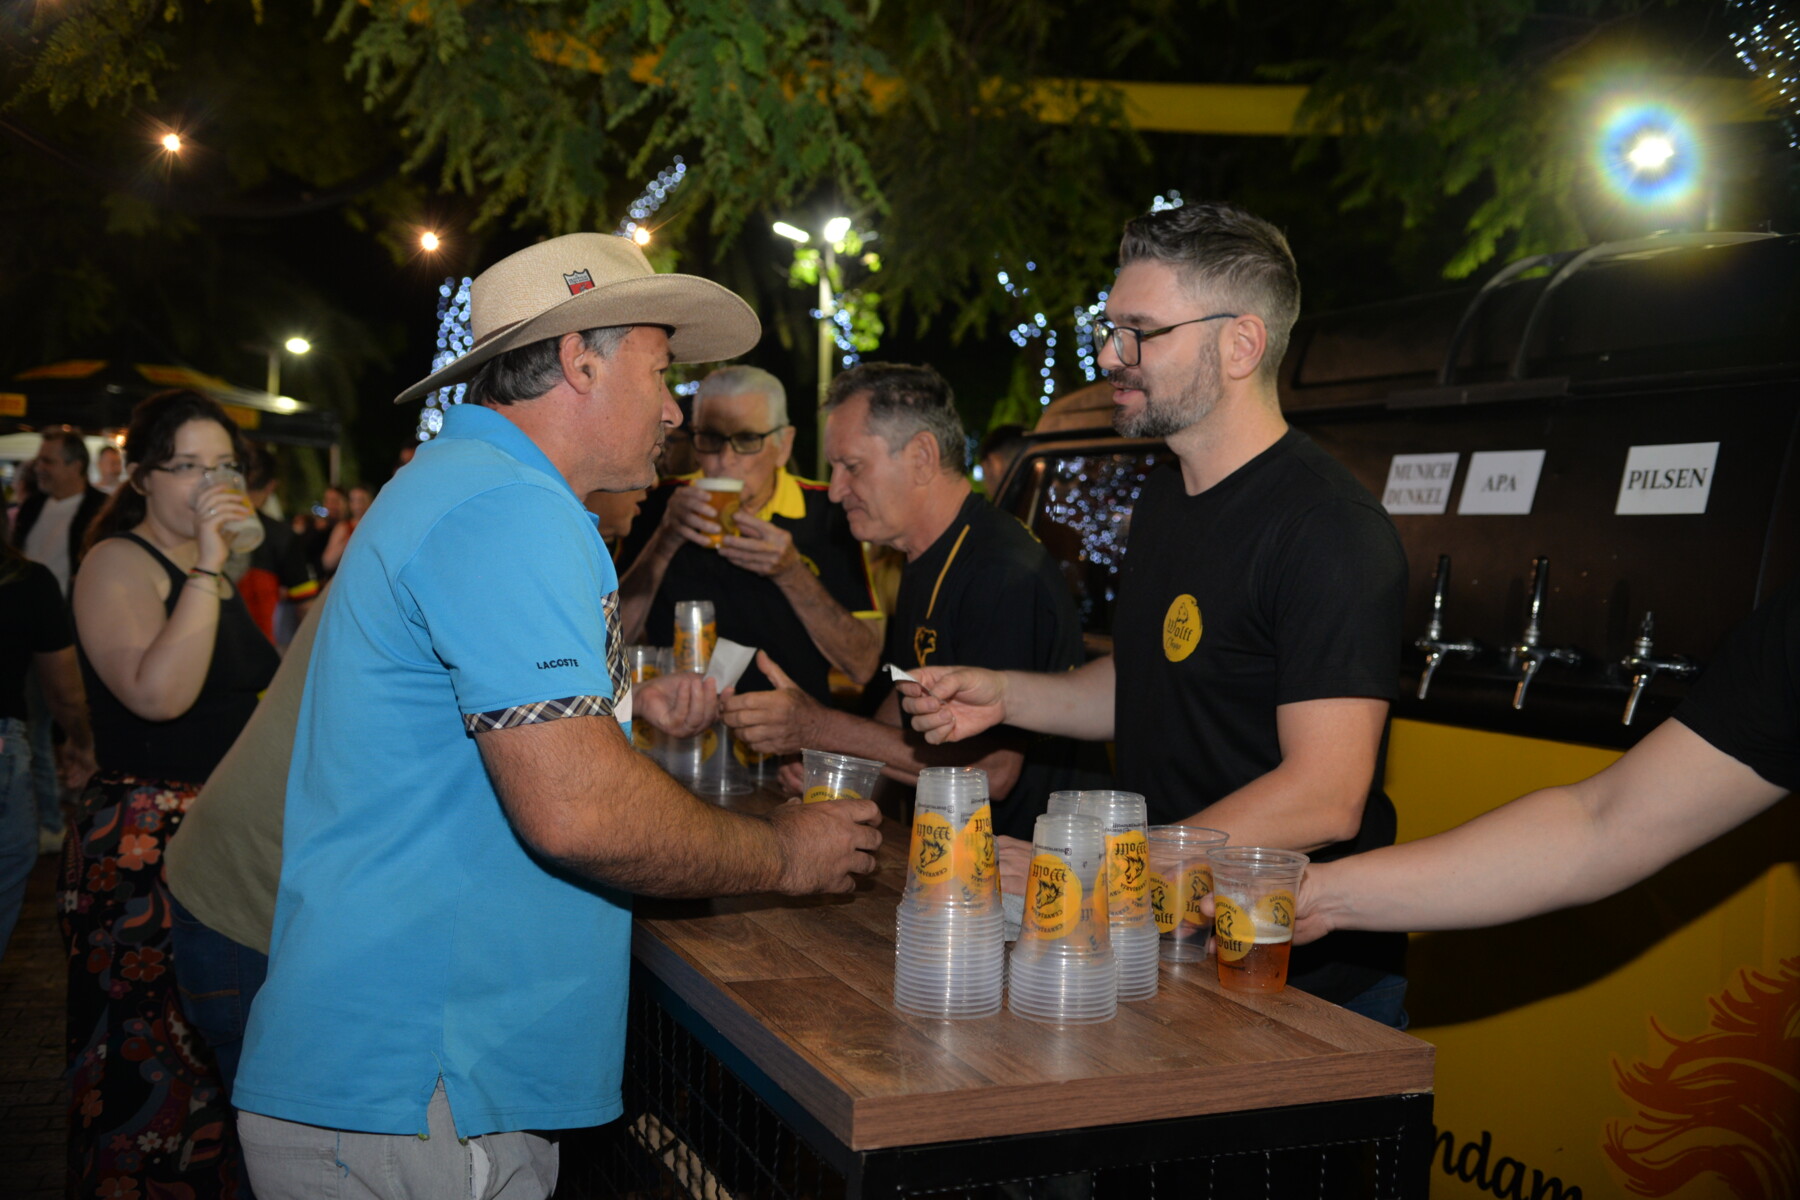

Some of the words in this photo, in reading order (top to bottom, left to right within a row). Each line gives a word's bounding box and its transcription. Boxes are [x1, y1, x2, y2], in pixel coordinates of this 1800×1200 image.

[1393, 462, 1453, 480] MUNICH
[1627, 467, 1708, 490] PILSEN
[1481, 474, 1517, 492] APA
[1386, 487, 1442, 505] DUNKEL
[1167, 618, 1193, 641] Wolff
[536, 658, 579, 669] LACOSTE
[1032, 864, 1067, 882] Wolff
[1154, 912, 1174, 924] olff
